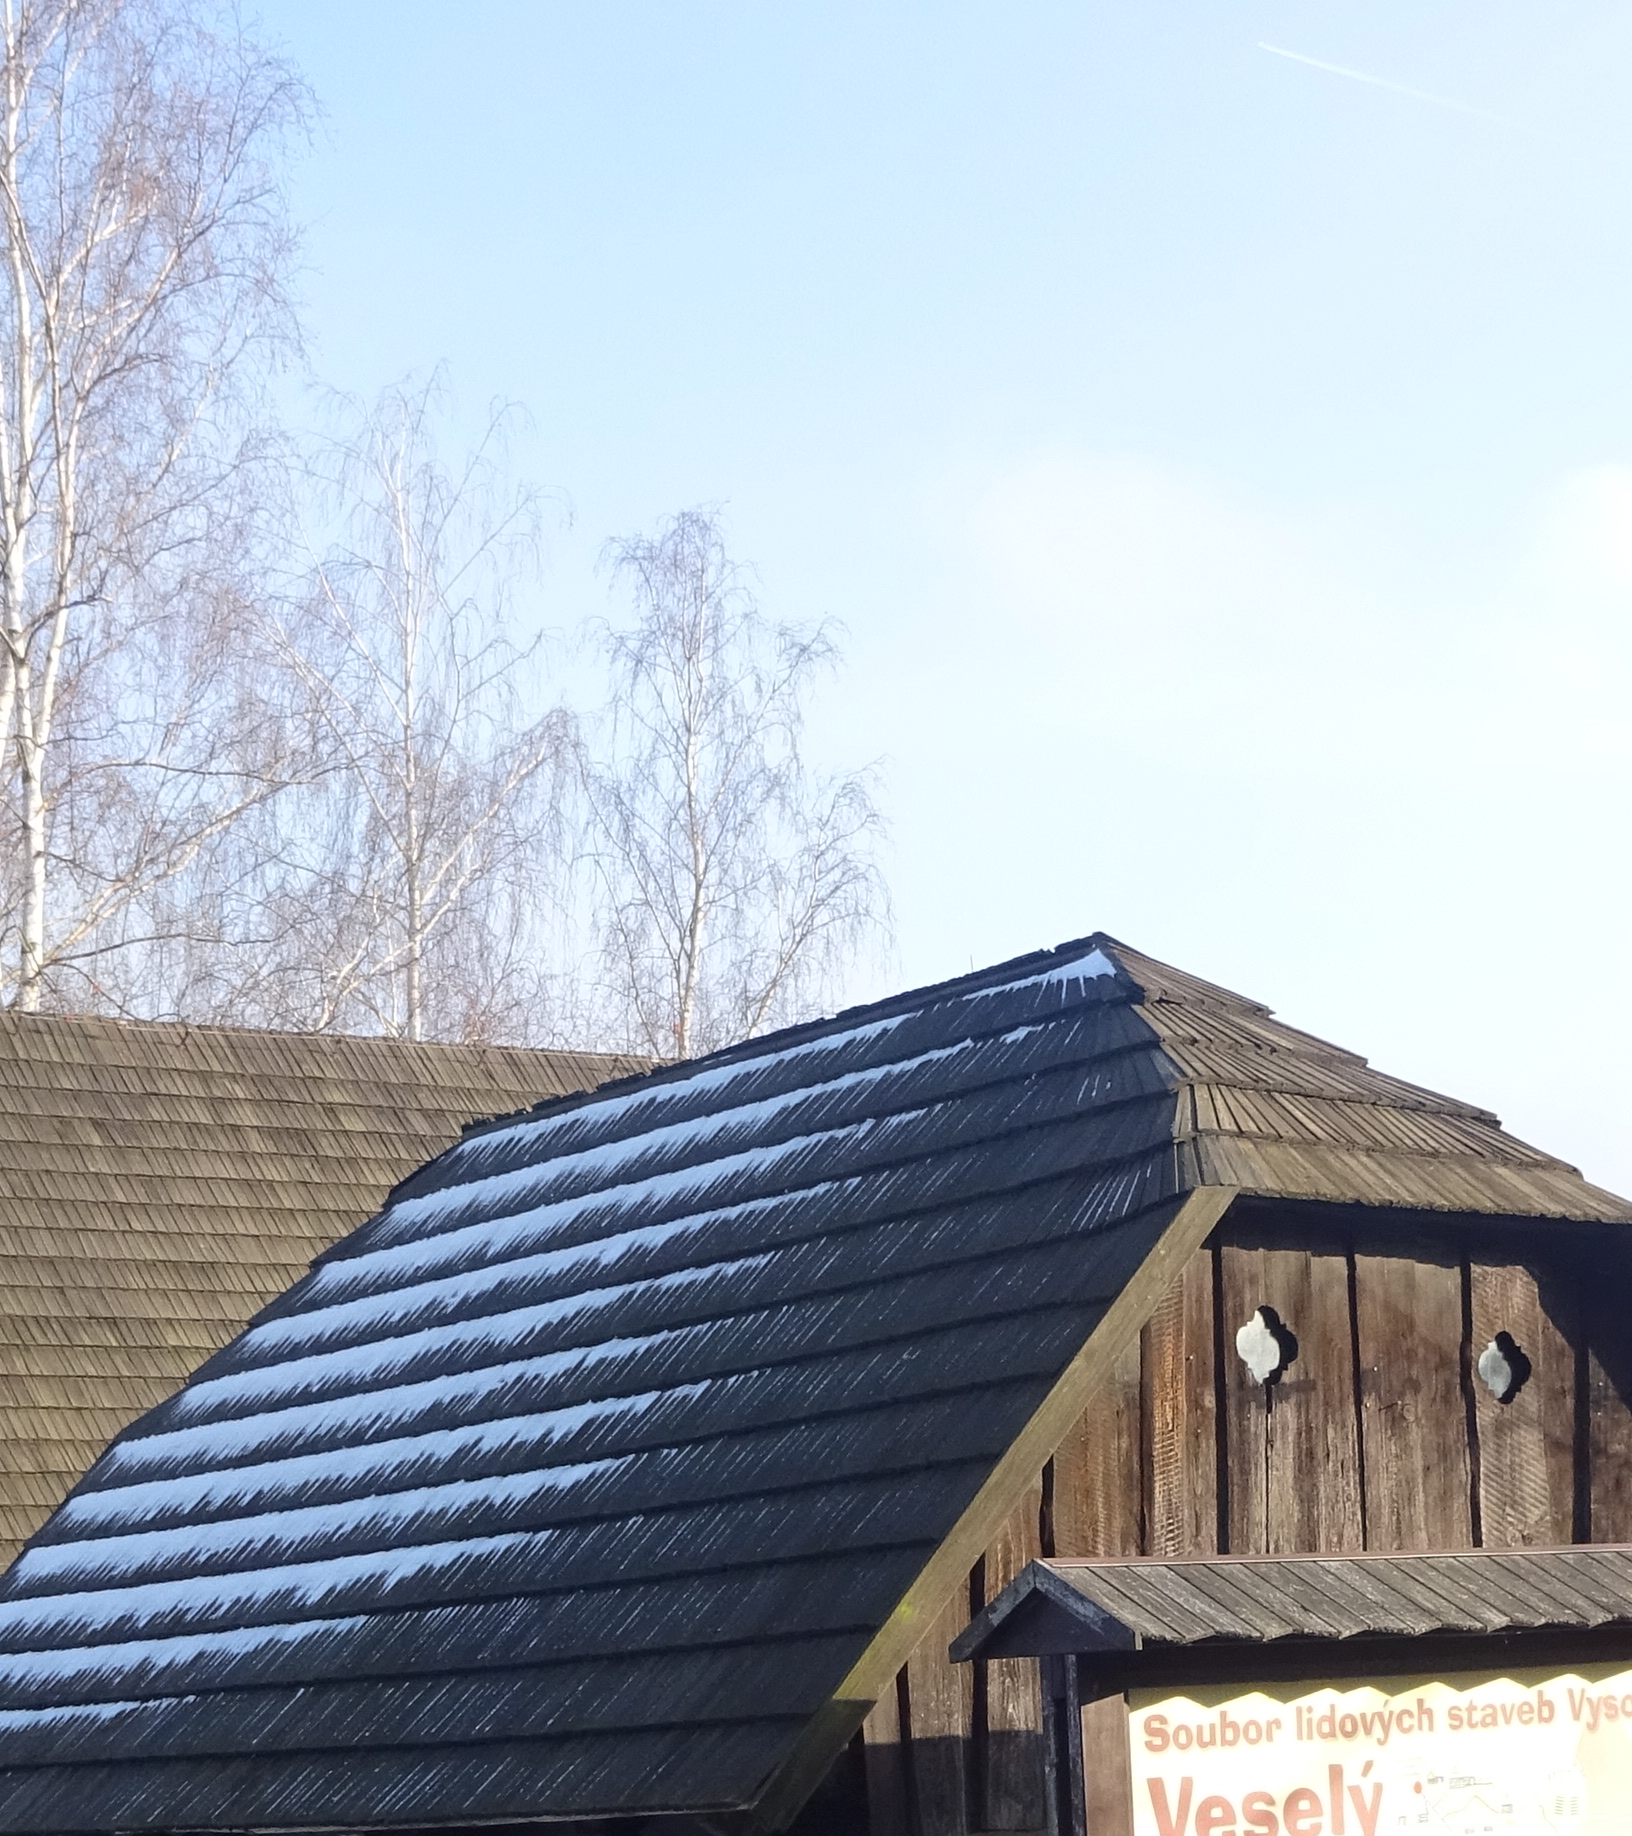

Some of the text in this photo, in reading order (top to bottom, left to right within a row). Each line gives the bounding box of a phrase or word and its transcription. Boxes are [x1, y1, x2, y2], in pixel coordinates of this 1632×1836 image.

[1144, 1711, 1281, 1752] Soubor
[1296, 1699, 1434, 1746] lidových
[1448, 1690, 1555, 1730] staveb
